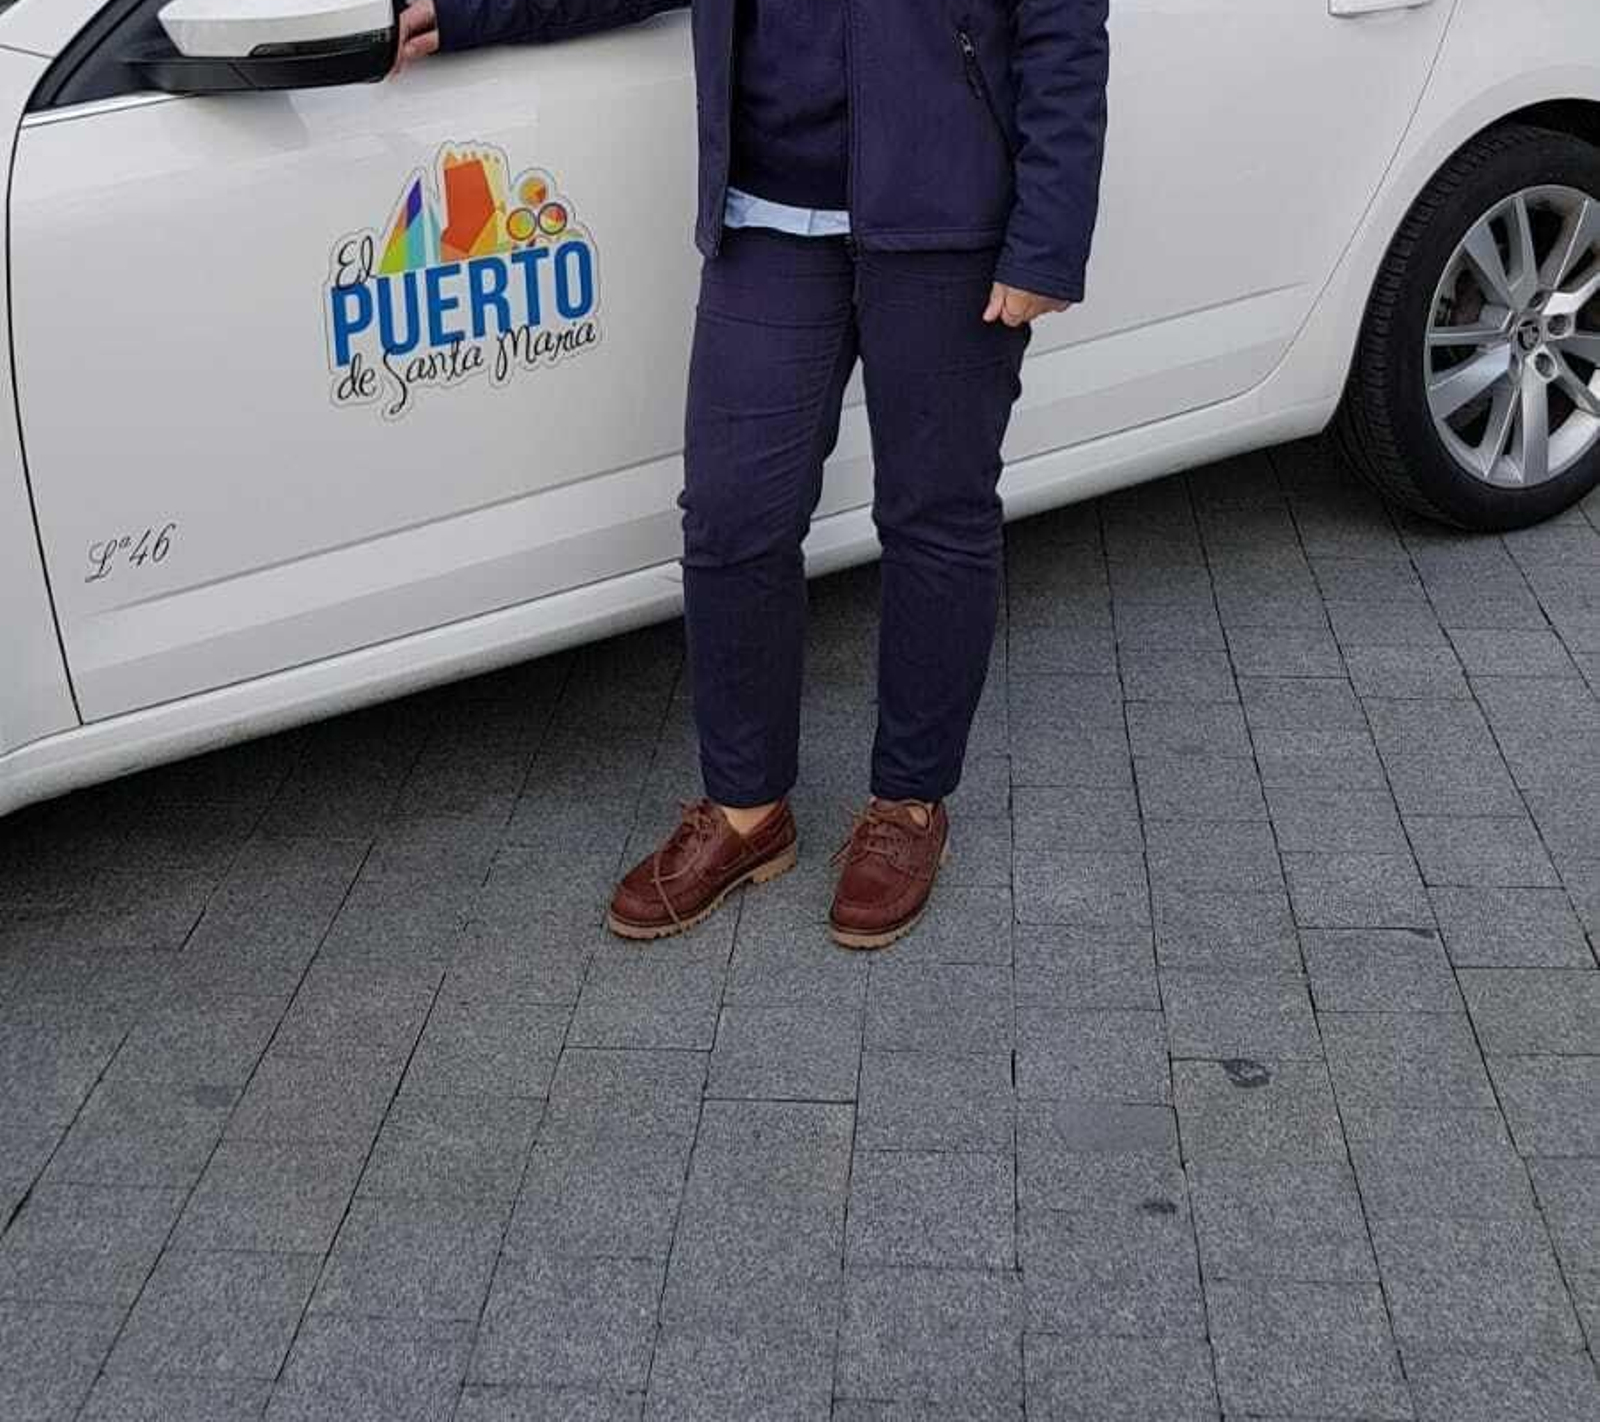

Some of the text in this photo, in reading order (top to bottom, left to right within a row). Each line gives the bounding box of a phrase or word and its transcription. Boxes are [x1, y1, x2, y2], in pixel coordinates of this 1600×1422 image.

[336, 235, 376, 290] El
[331, 240, 594, 368] PUERTO
[337, 353, 377, 400] de
[383, 341, 484, 415] Santa
